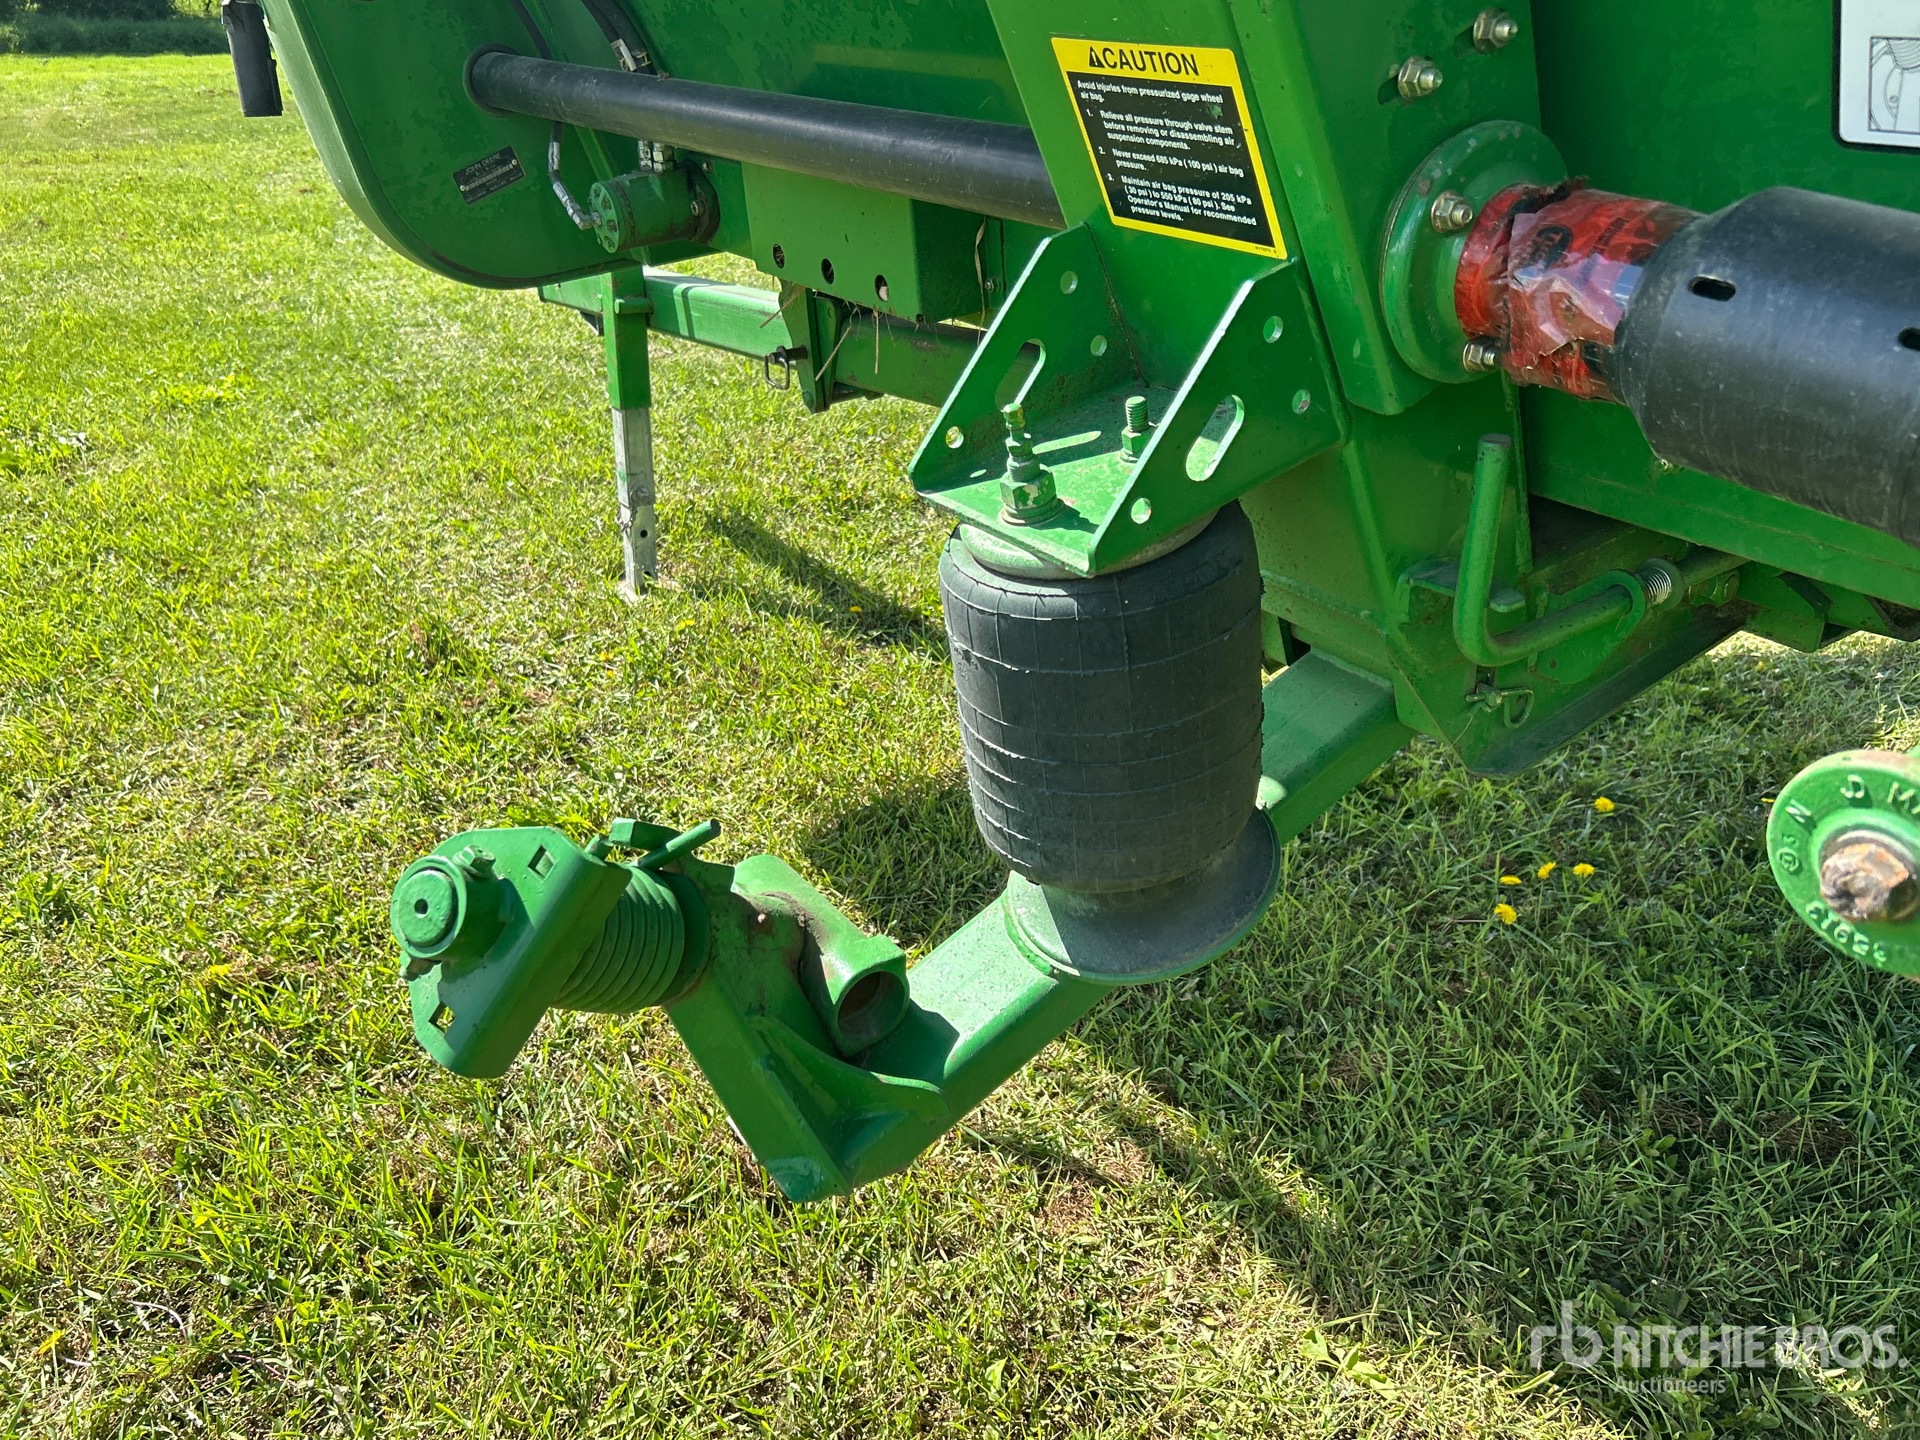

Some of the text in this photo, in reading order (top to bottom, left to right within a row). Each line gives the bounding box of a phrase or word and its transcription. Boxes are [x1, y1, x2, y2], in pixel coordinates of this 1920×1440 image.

[1102, 47, 1200, 77] CAUTION
[1077, 80, 1223, 103] Avoid injuries from pressurized gage wheel
[1080, 91, 1105, 102] air bag.
[1086, 109, 1233, 134] 1. Relieve all pressure through valve stem
[1103, 121, 1125, 130] before
[1126, 125, 1159, 137] removing
[1169, 130, 1224, 146] disassembling
[1224, 137, 1235, 146] air
[1107, 132, 1191, 150] suspension components.
[465, 153, 501, 175] JOHN DEERE
[1098, 146, 1106, 154] 2.
[1112, 148, 1131, 158] Never
[1132, 152, 1155, 162] exceed
[1169, 157, 1183, 166] kPa
[1188, 160, 1200, 169] 100
[1201, 163, 1213, 172] psi
[1218, 165, 1227, 173] air
[1228, 166, 1244, 178] bag
[1116, 160, 1147, 170] pressure.
[1107, 173, 1252, 205] 3. Maintain air bag pressure of 205 kPa
[1137, 188, 1148, 197] psi
[1160, 192, 1173, 201] 550
[1174, 194, 1187, 204] kPa
[1202, 200, 1214, 209] psi
[1220, 202, 1235, 212] See
[1127, 195, 1257, 226] Operator's Manual for recommended
[1130, 205, 1184, 221] pressure levels.
